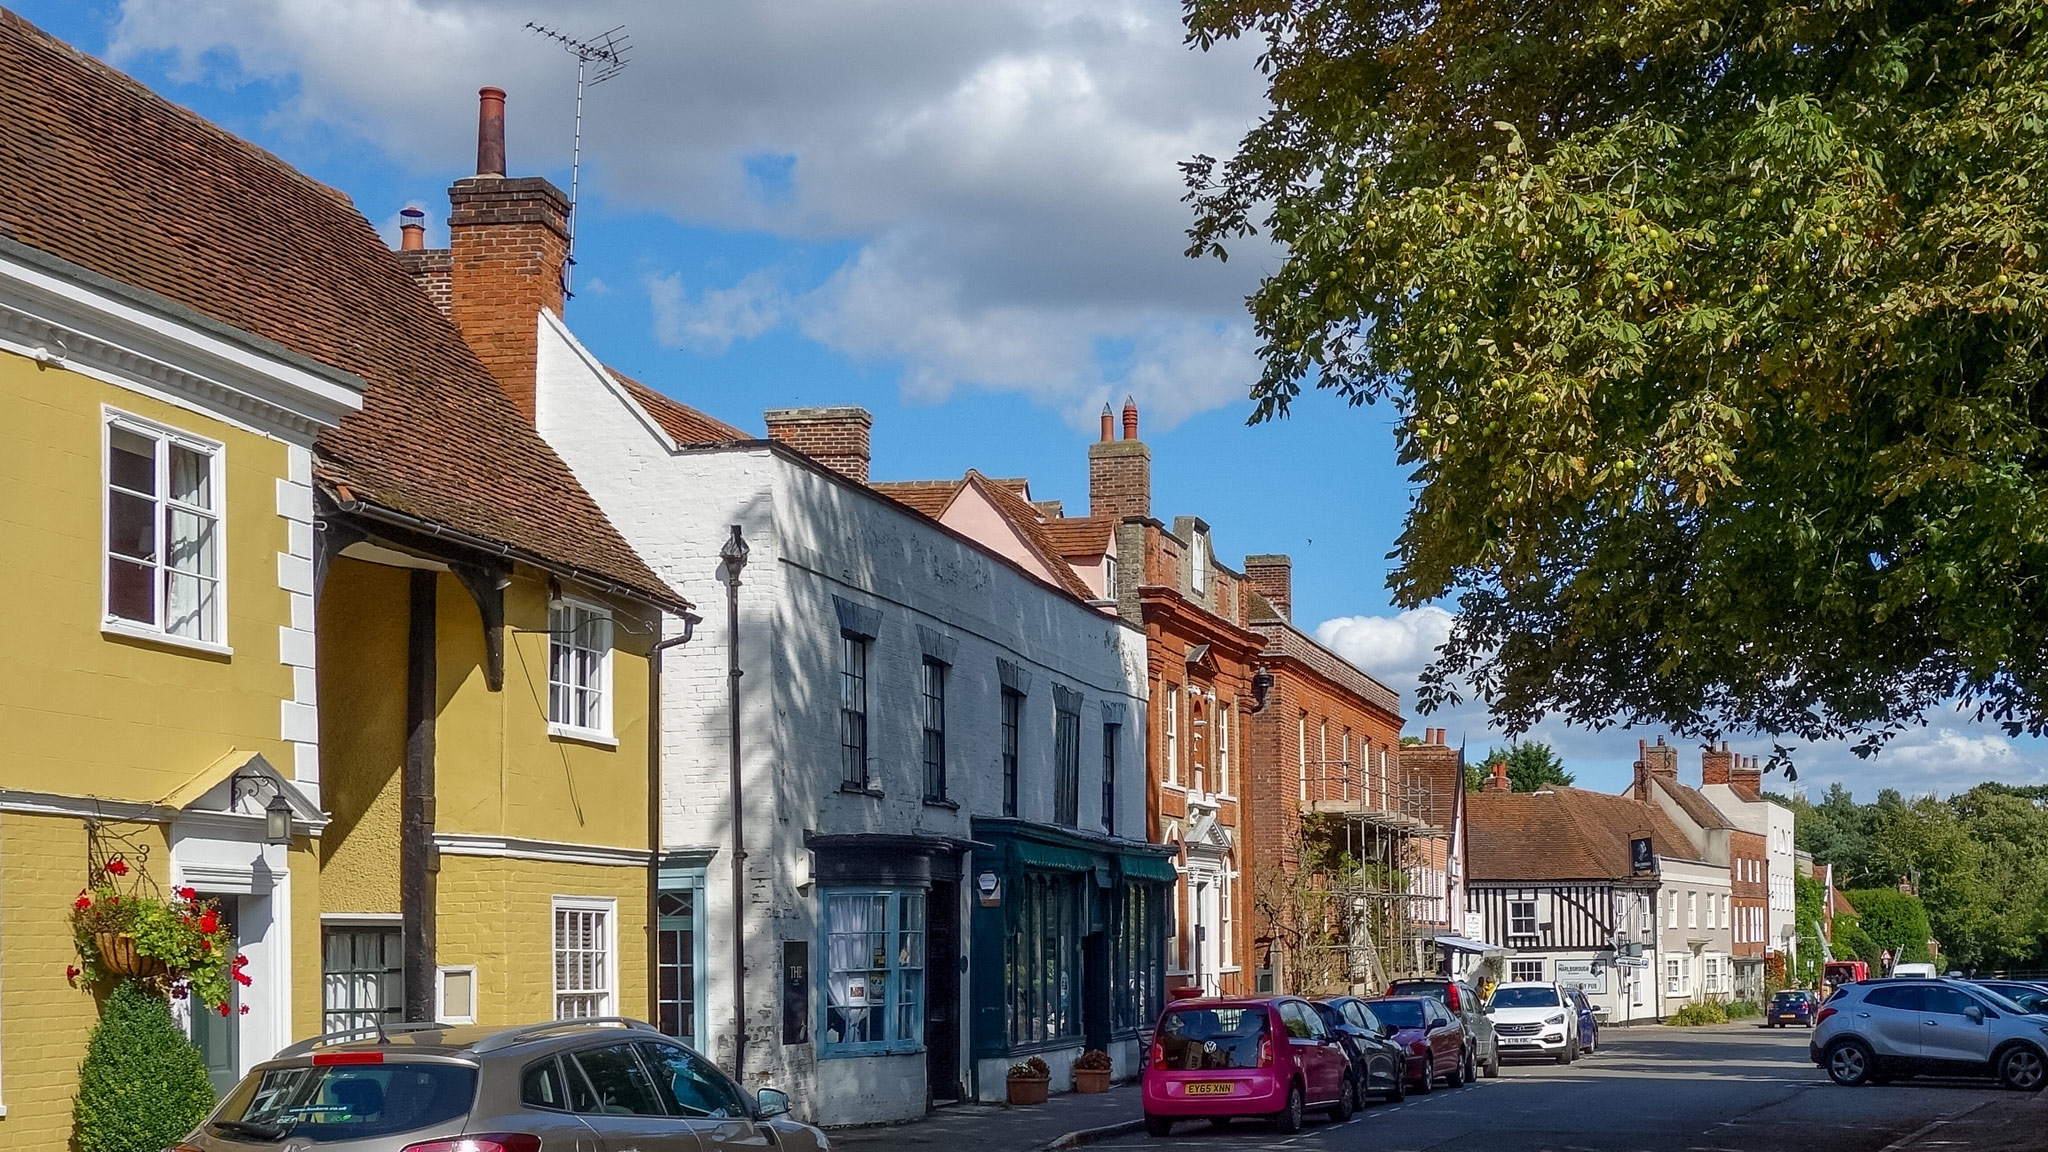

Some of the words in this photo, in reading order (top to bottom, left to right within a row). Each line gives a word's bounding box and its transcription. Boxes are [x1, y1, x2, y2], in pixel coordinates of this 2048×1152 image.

[790, 966, 803, 979] THE
[1188, 1084, 1212, 1093] EY65
[1213, 1084, 1231, 1093] XNN
